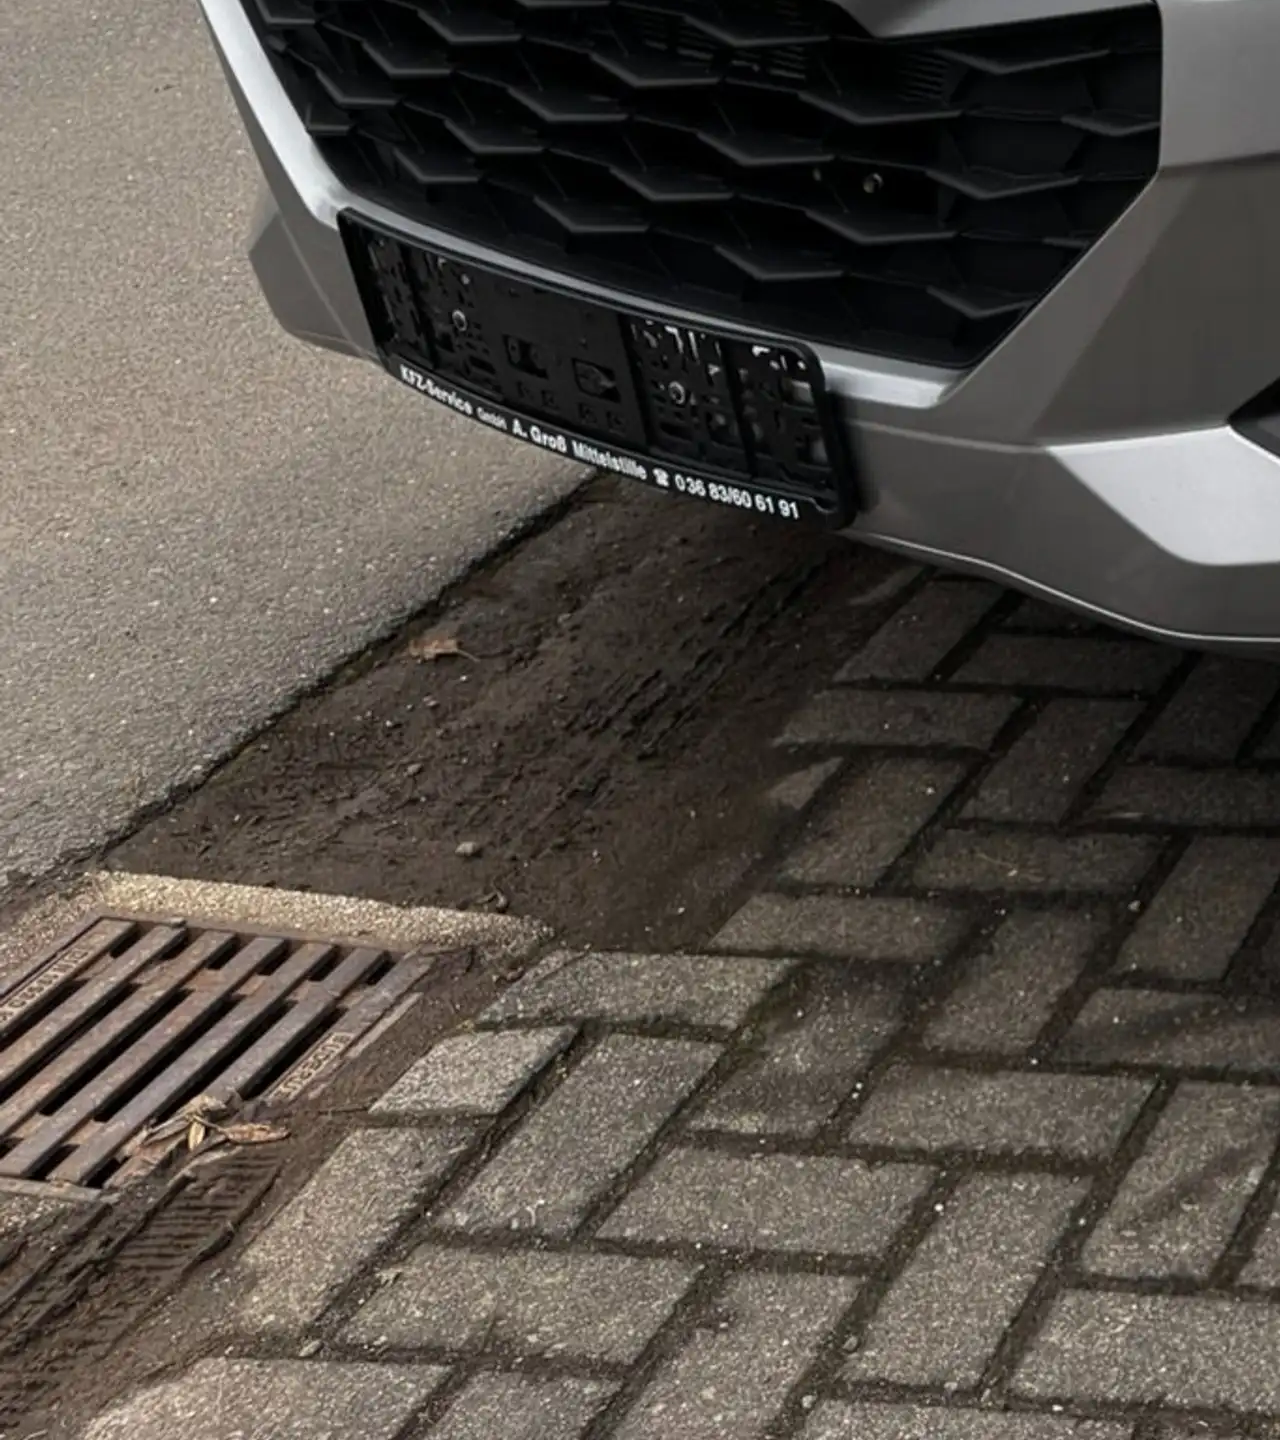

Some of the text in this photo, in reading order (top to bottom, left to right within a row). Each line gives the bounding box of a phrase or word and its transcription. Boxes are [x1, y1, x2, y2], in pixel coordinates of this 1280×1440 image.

[400, 363, 473, 415] KFZ-Service
[530, 425, 567, 453] Groß
[755, 493, 775, 515] 61
[778, 498, 800, 520] 91
